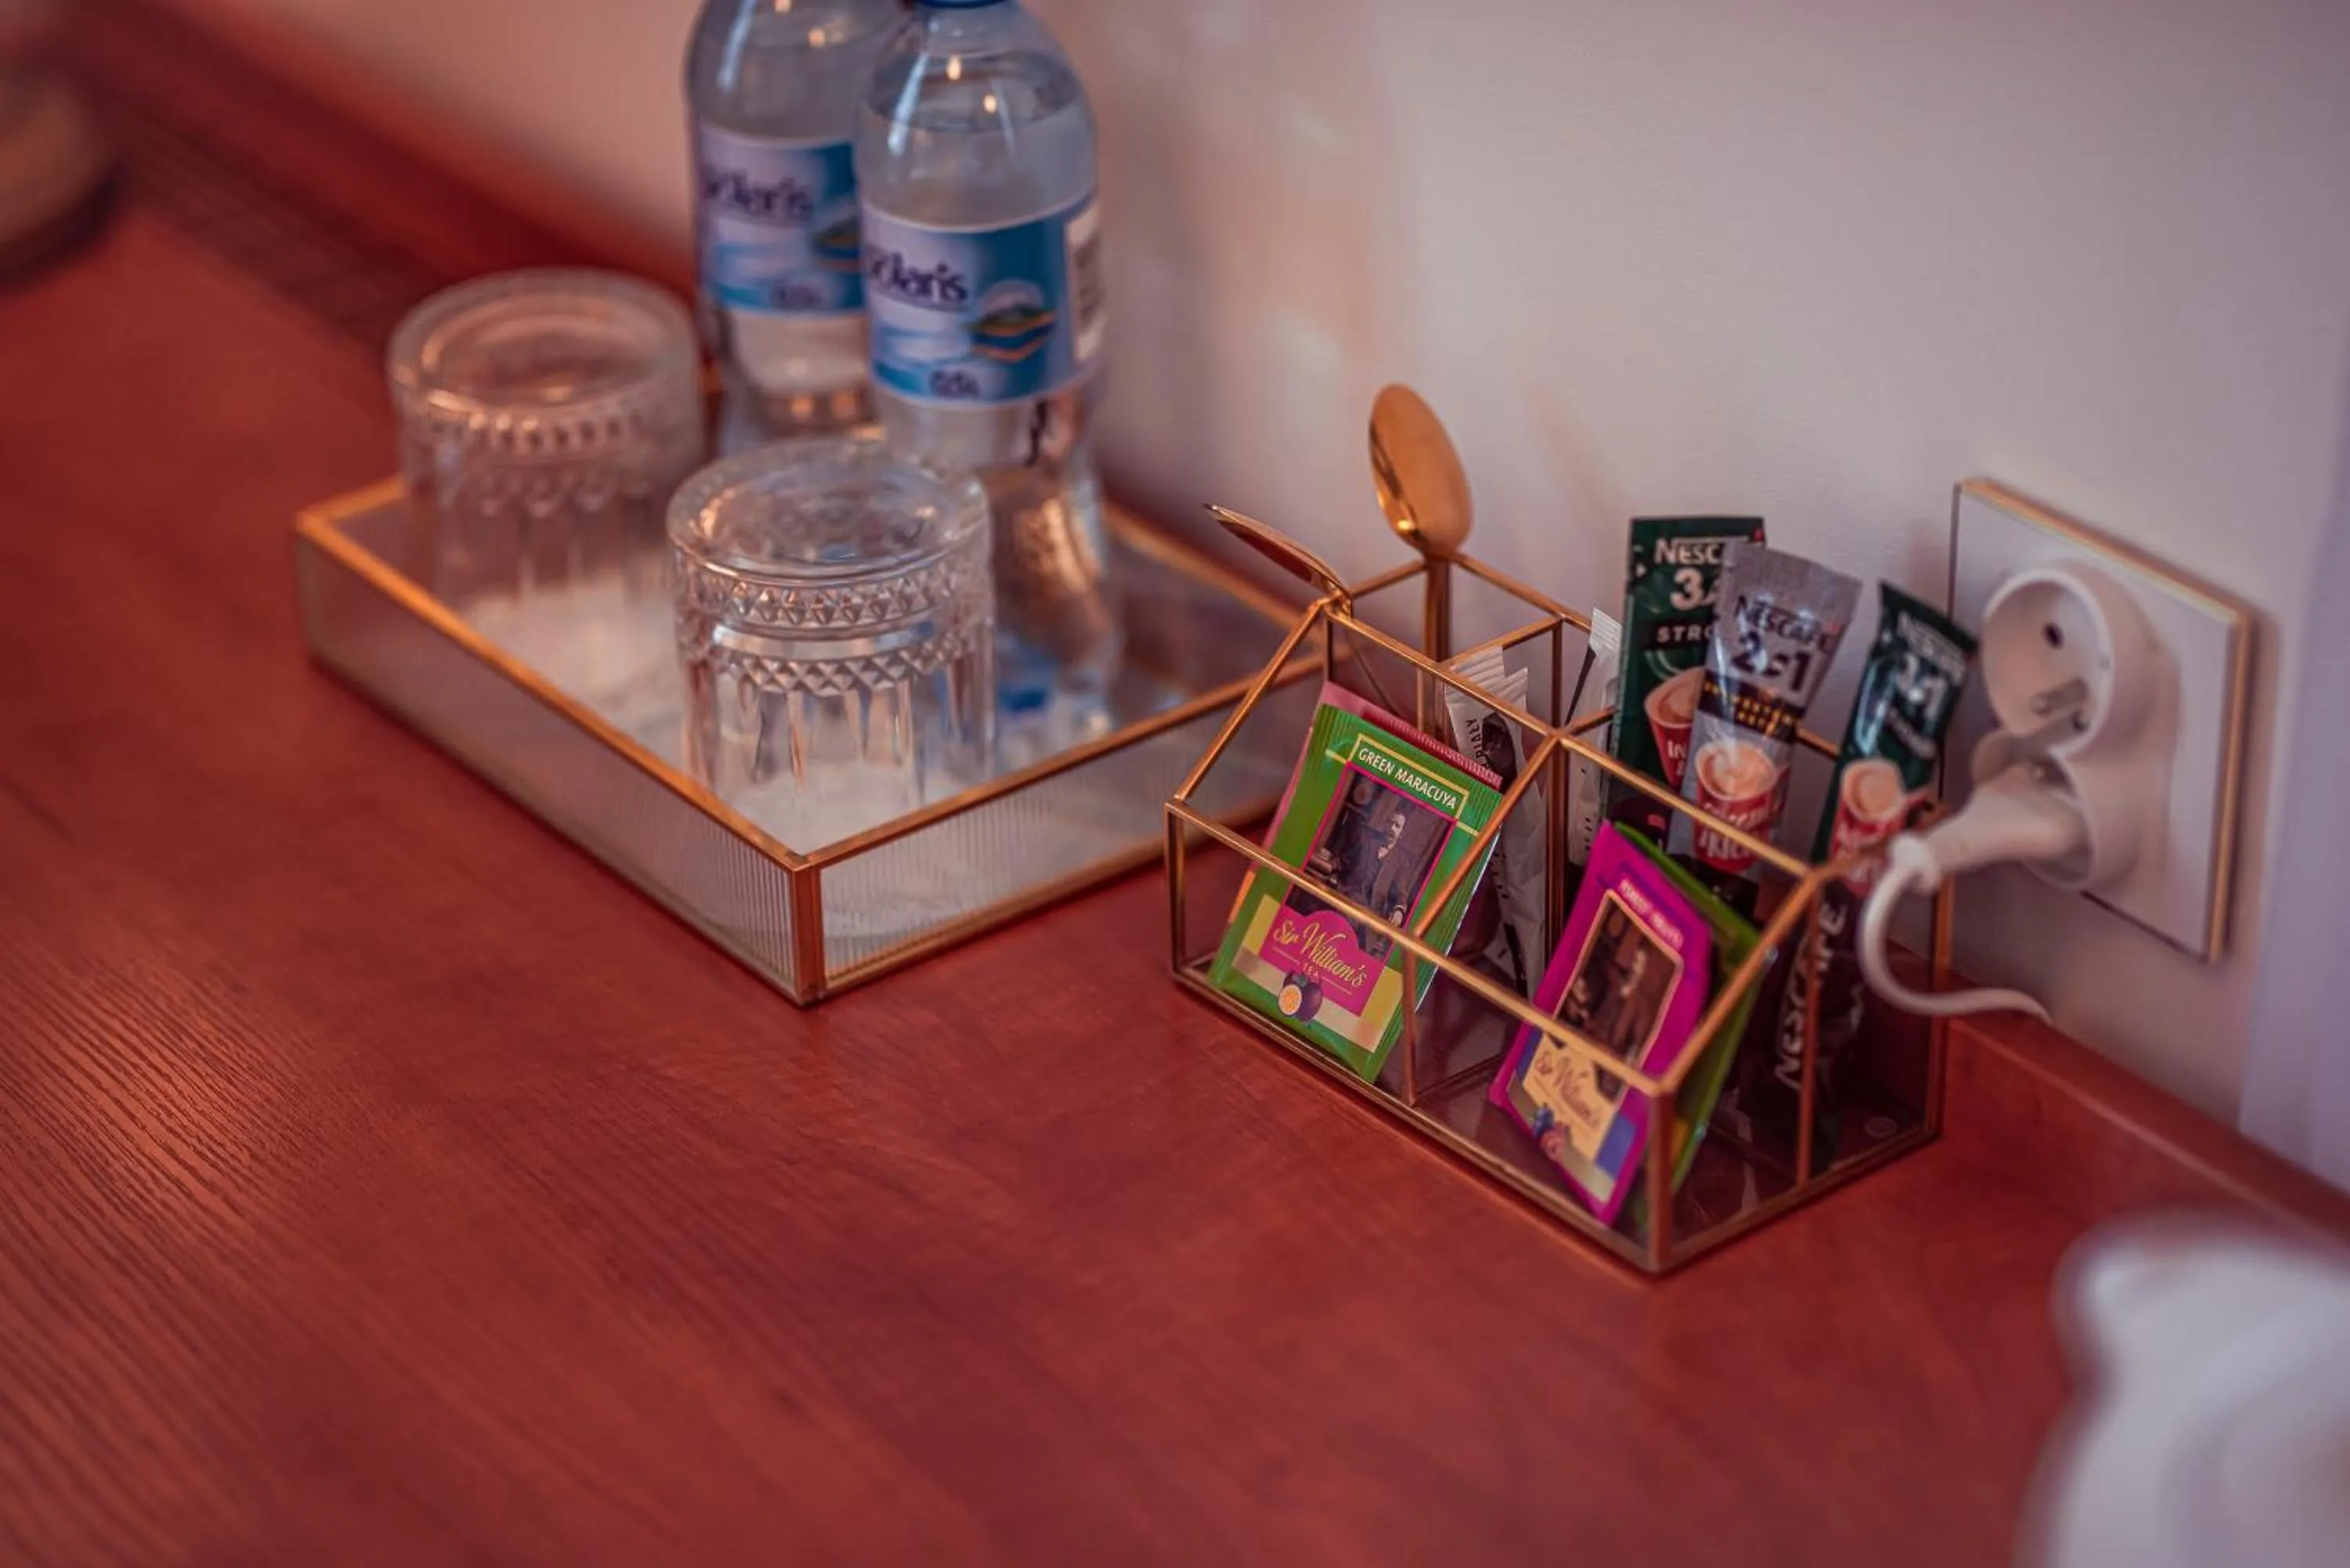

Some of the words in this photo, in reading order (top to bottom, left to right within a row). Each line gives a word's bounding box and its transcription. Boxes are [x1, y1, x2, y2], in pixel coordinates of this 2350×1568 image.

[1654, 537, 1721, 565] NESC
[1358, 748, 1395, 775] GREEN
[1394, 768, 1457, 810] MARACUYA
[1273, 920, 1300, 945] Sir
[1300, 922, 1367, 988] William's
